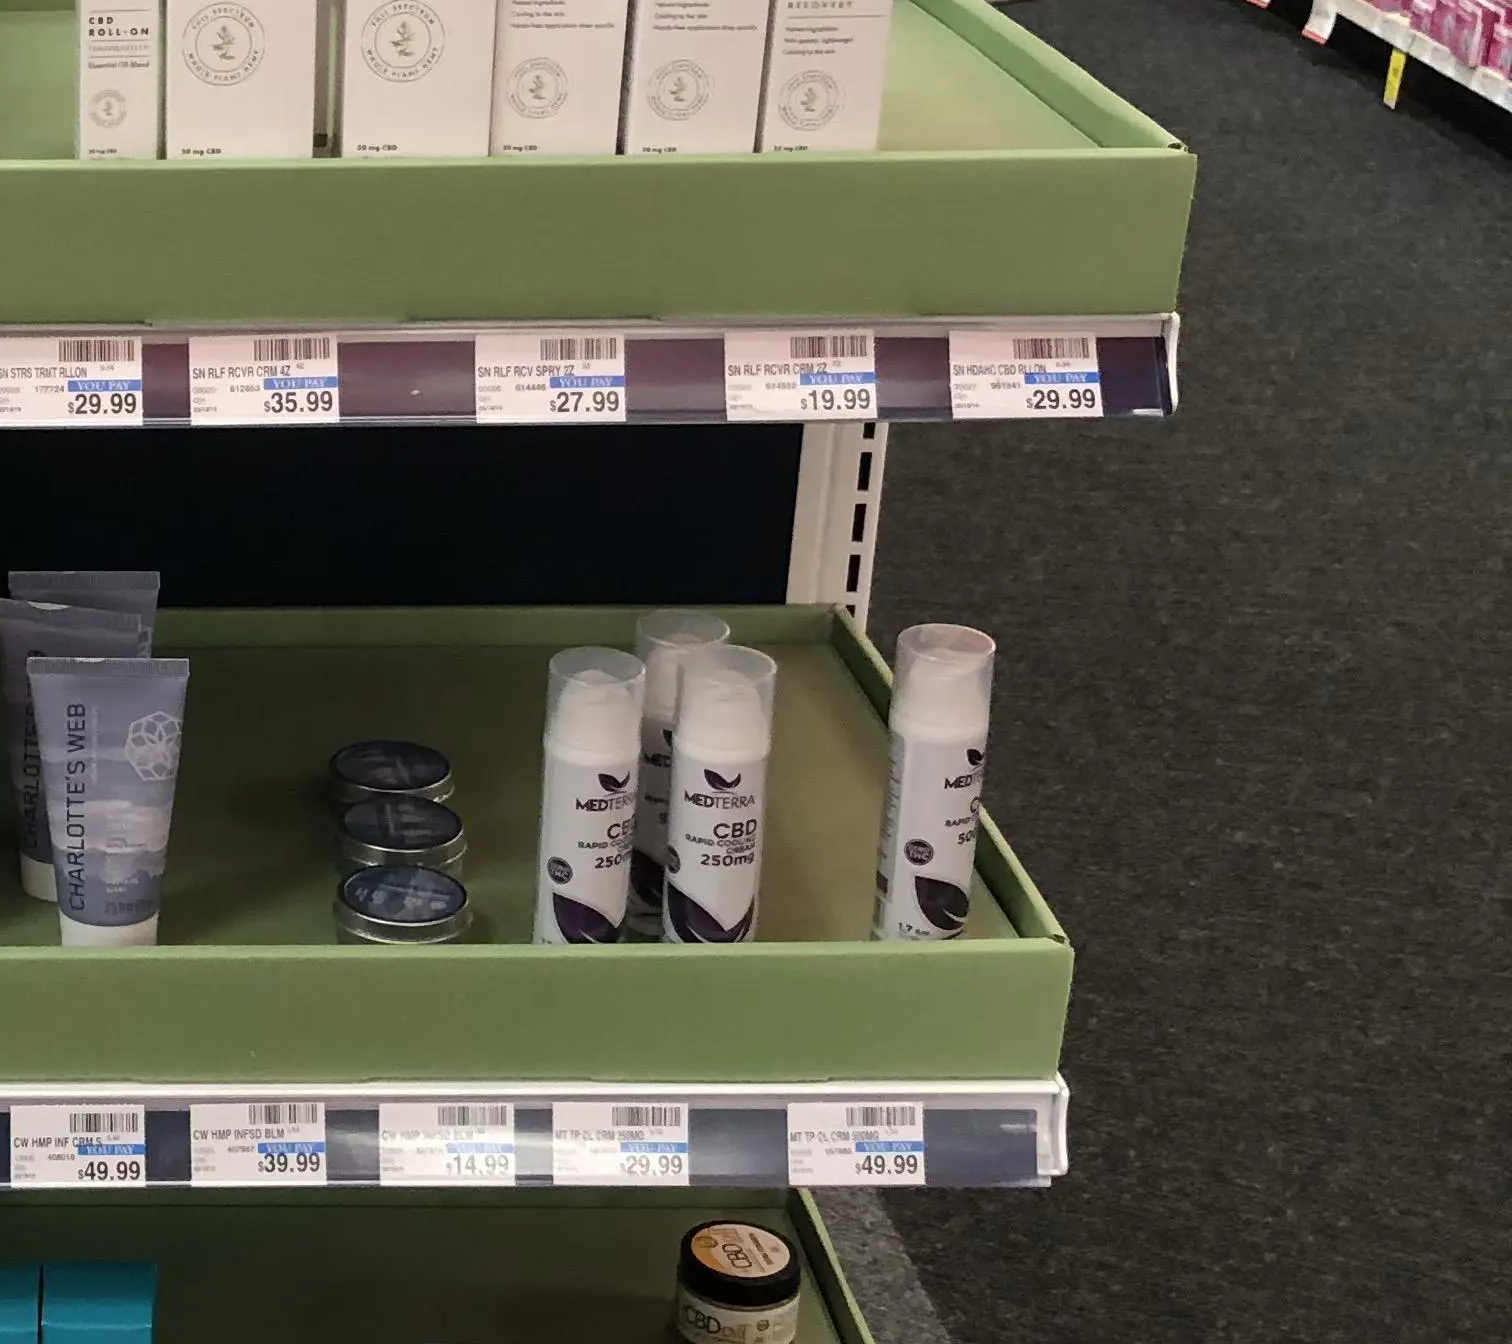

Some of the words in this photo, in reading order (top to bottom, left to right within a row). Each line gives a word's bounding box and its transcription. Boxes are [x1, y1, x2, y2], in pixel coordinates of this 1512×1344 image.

[88, 16, 114, 25] CBD
[88, 27, 150, 37] ROLL-ON
[68, 392, 137, 415] $29.99
[264, 391, 334, 413] $35.99
[549, 391, 619, 414] $27.99
[800, 389, 871, 411] $19.99
[1026, 389, 1096, 409] $29.99
[67, 703, 86, 753] WEB
[684, 790, 756, 810] MEDTERRA
[67, 761, 86, 911] CHARLOTTE'S
[713, 819, 757, 840] CBD
[685, 834, 714, 846] RAPID
[700, 853, 756, 868] 250mg
[78, 1161, 141, 1181] $49.99
[258, 1153, 320, 1173] $39.99
[446, 1155, 509, 1177] $14.99
[620, 1155, 683, 1176] $29.99
[855, 1155, 918, 1175] $49.99
